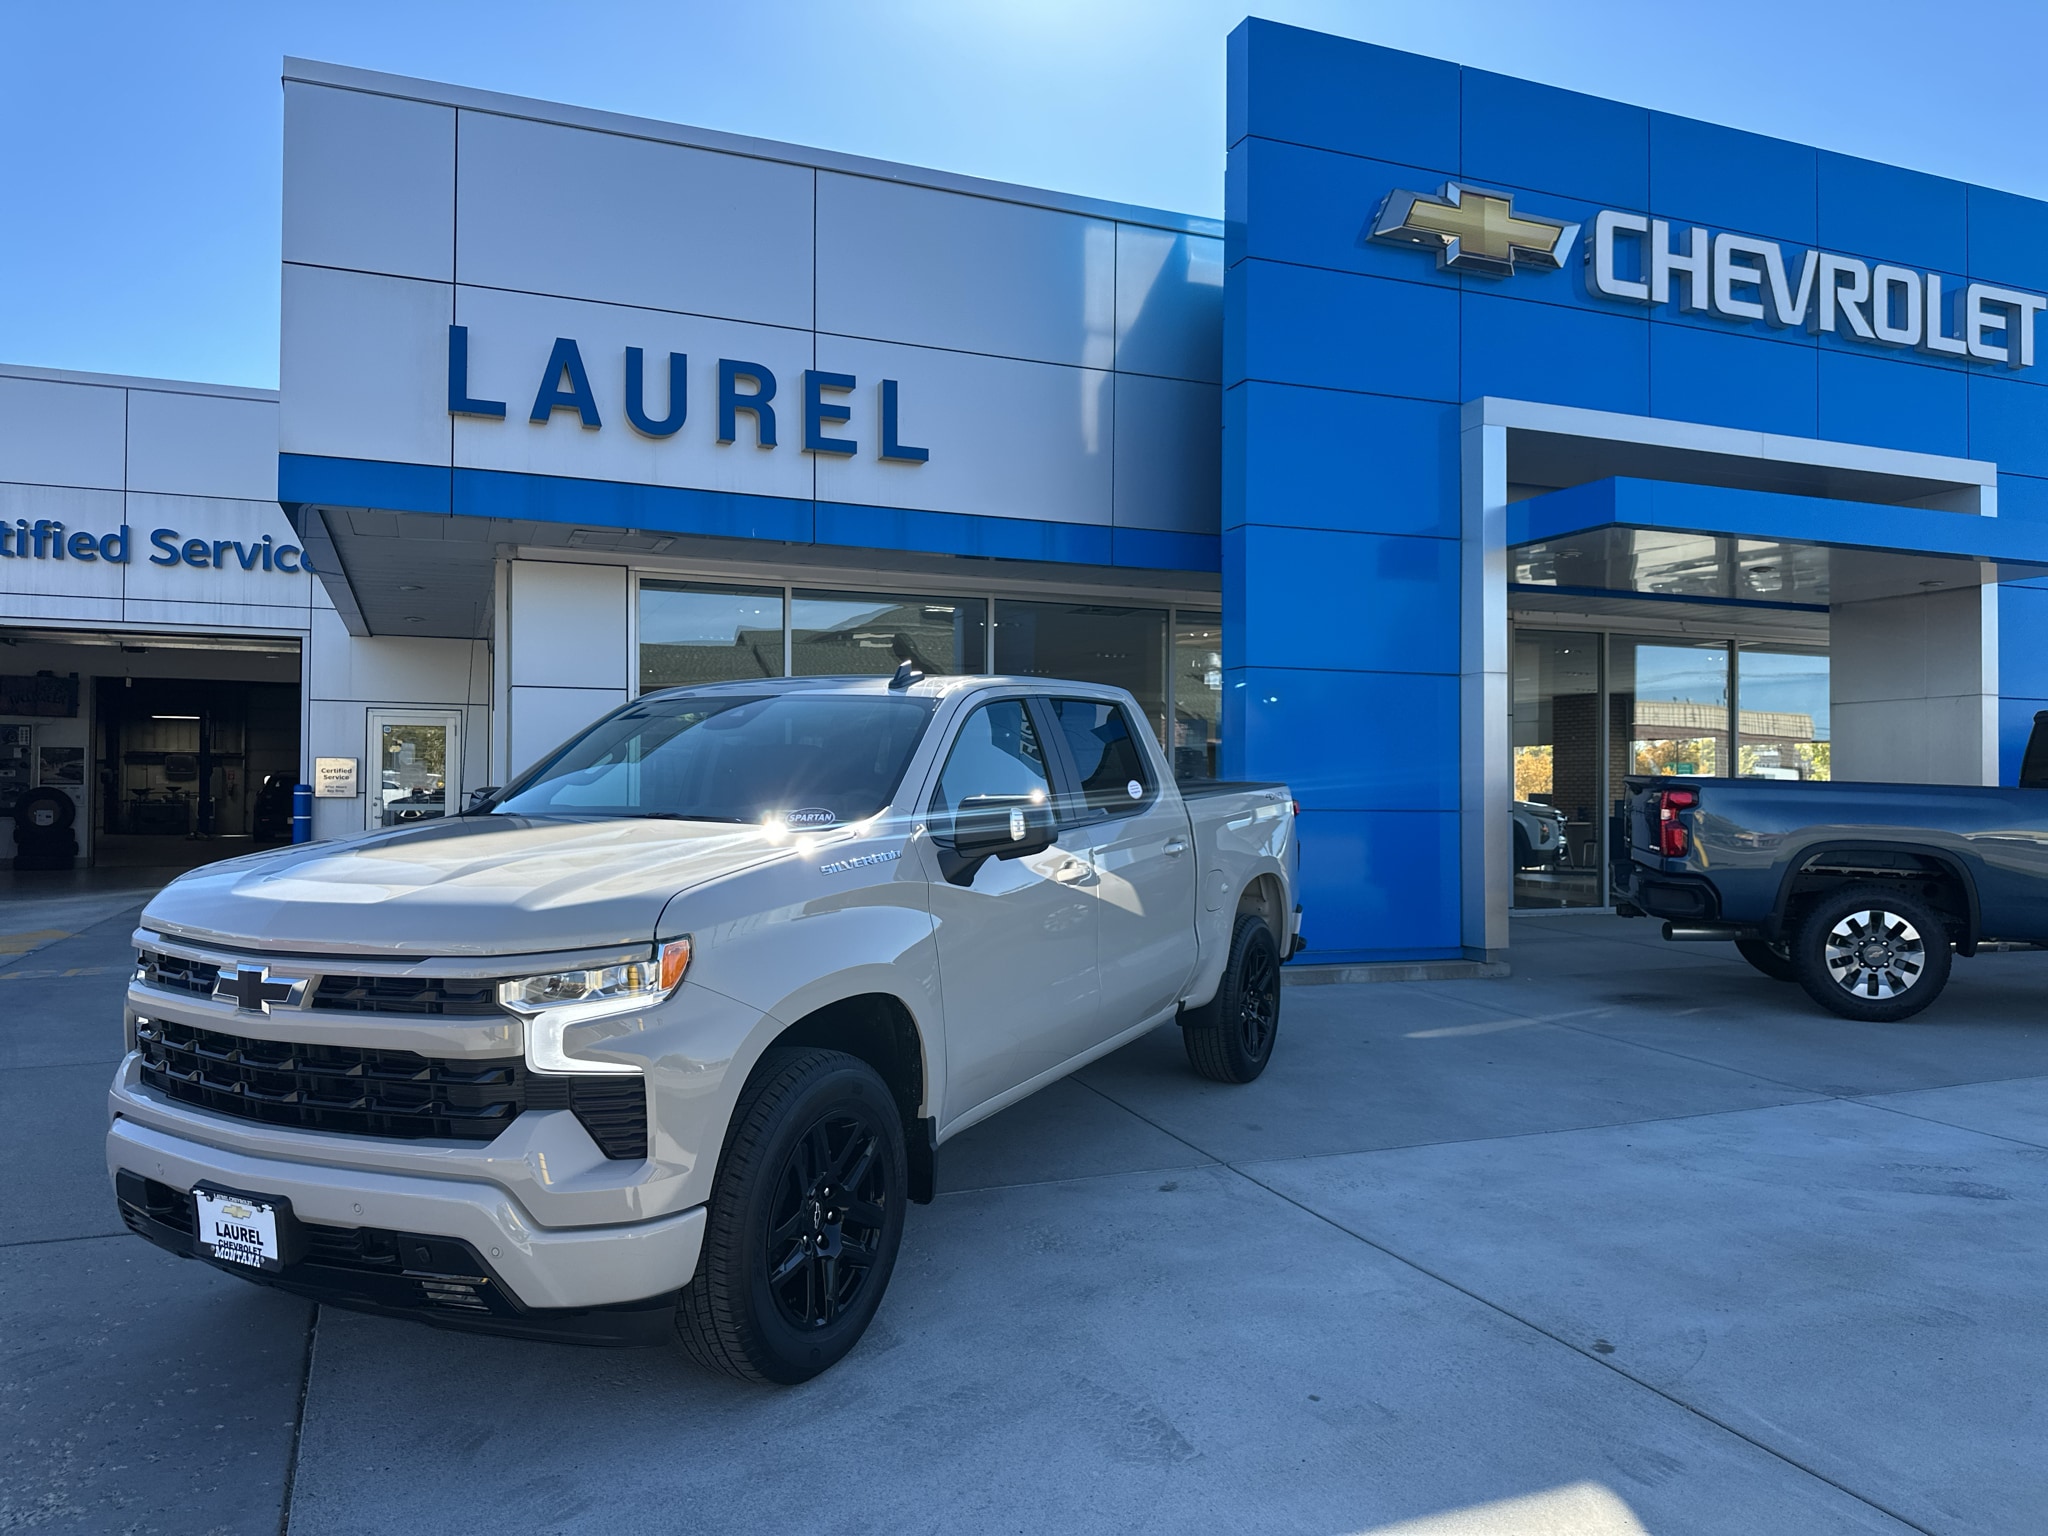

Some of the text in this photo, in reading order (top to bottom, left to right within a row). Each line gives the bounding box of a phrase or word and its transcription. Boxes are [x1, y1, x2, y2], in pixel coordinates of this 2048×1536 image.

[1587, 209, 2048, 369] CHEVROLET
[448, 324, 930, 464] LAUREL
[788, 813, 832, 822] SPARTAN
[819, 850, 902, 876] SILVERADO
[215, 1222, 264, 1246] LAUREL
[214, 1245, 261, 1268] MONTANA
[218, 1239, 262, 1257] CHEVROLET
